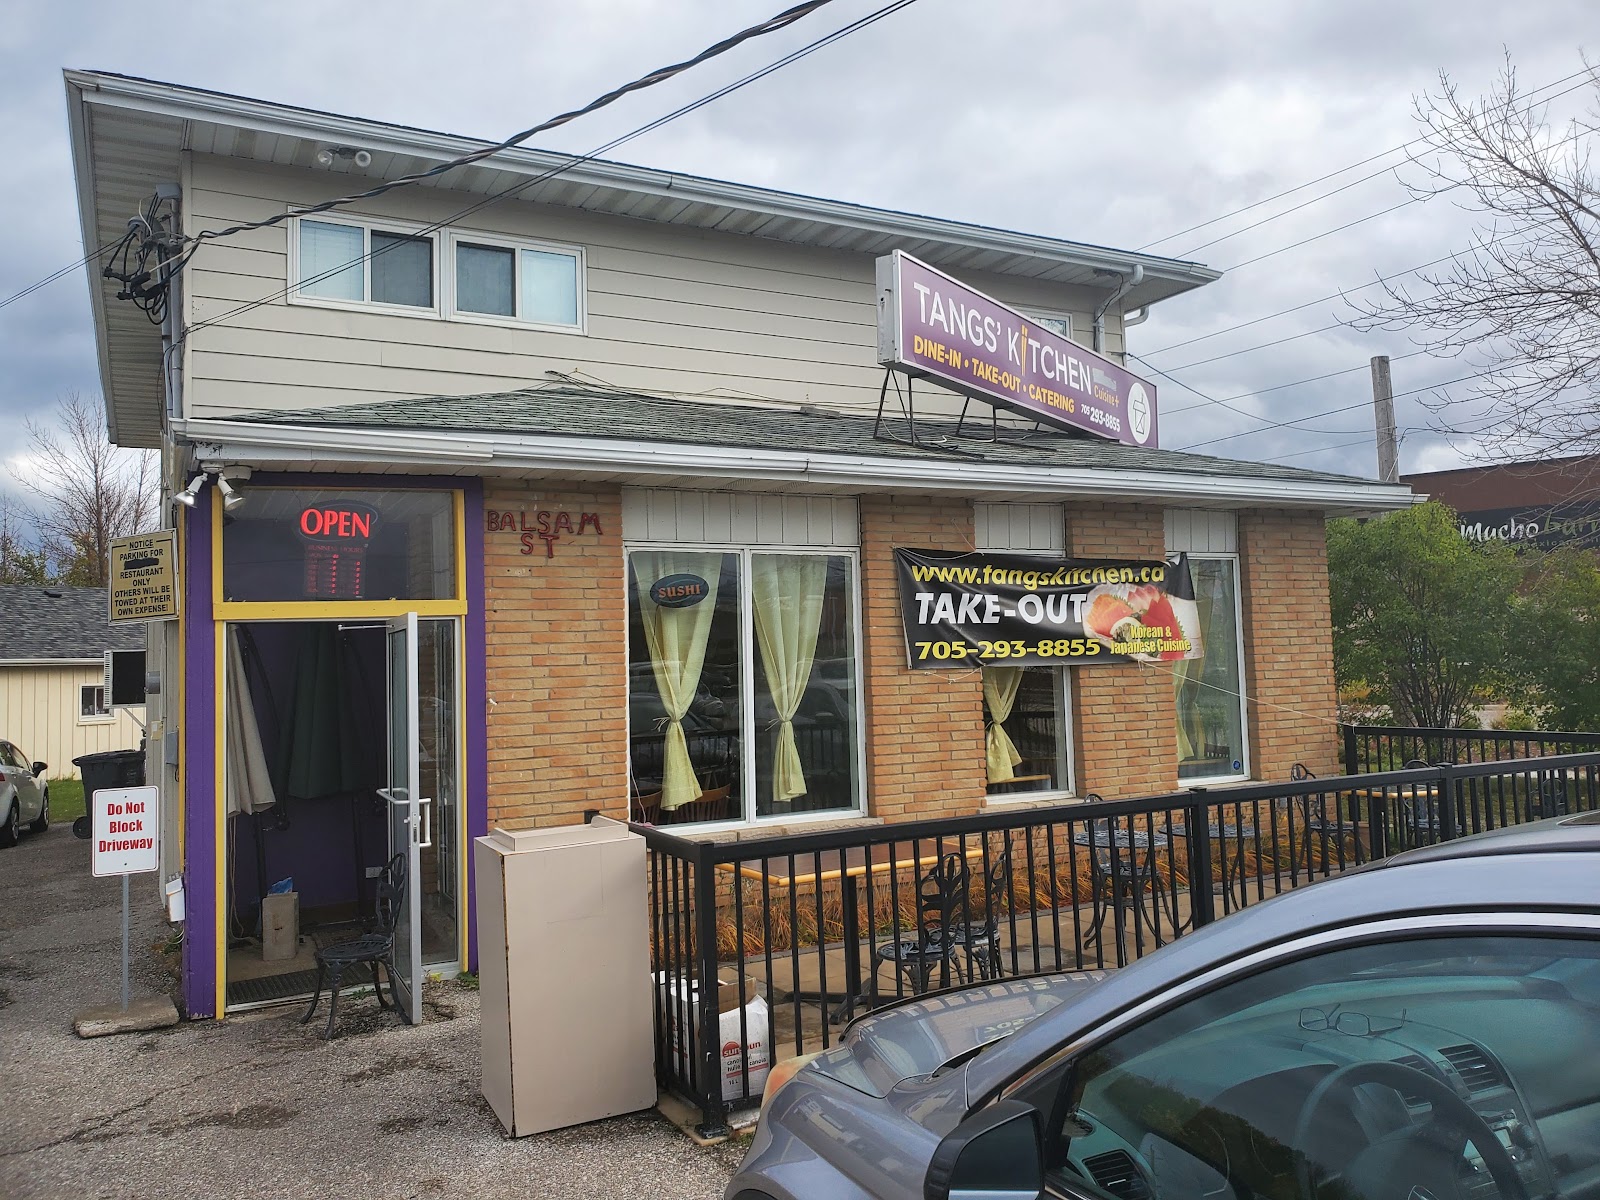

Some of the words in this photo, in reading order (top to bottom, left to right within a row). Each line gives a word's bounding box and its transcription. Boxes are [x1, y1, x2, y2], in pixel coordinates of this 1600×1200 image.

[1008, 324, 1092, 396] KITCHEN
[914, 335, 962, 368] DINE-IN
[972, 358, 1021, 394] TAKE-OUT
[1028, 383, 1075, 414] CATERING
[1081, 404, 1091, 416] 705
[1090, 407, 1121, 433] 293-8855
[300, 508, 371, 538] OPEN
[487, 510, 604, 536] BALSAM
[1460, 517, 1540, 542] Mucho
[129, 539, 154, 549] NOTICE
[520, 533, 560, 559] ST
[120, 551, 149, 561] PARKING
[150, 549, 164, 557] FOR
[120, 567, 164, 579] RESTAURANT
[911, 564, 1165, 591] www.tangskitchen.ca
[132, 578, 151, 587] ONLY
[114, 589, 141, 598] OTHERS
[143, 586, 159, 595] WILL
[161, 585, 171, 593] BE
[658, 583, 701, 599] SUSHI
[115, 598, 138, 607] TOWED
[150, 595, 171, 603] THEIR
[914, 592, 1087, 625] TAKE-OUT
[117, 608, 133, 616] OWN
[1130, 625, 1164, 639] Korean
[1165, 625, 1172, 637] &
[914, 638, 1101, 660] 705-293-8855
[1110, 641, 1156, 655] Japanese
[1156, 638, 1191, 652] Cuisine
[107, 803, 123, 816] Do
[125, 801, 145, 814] Not
[109, 819, 143, 833] Block
[98, 838, 153, 853] Driveway
